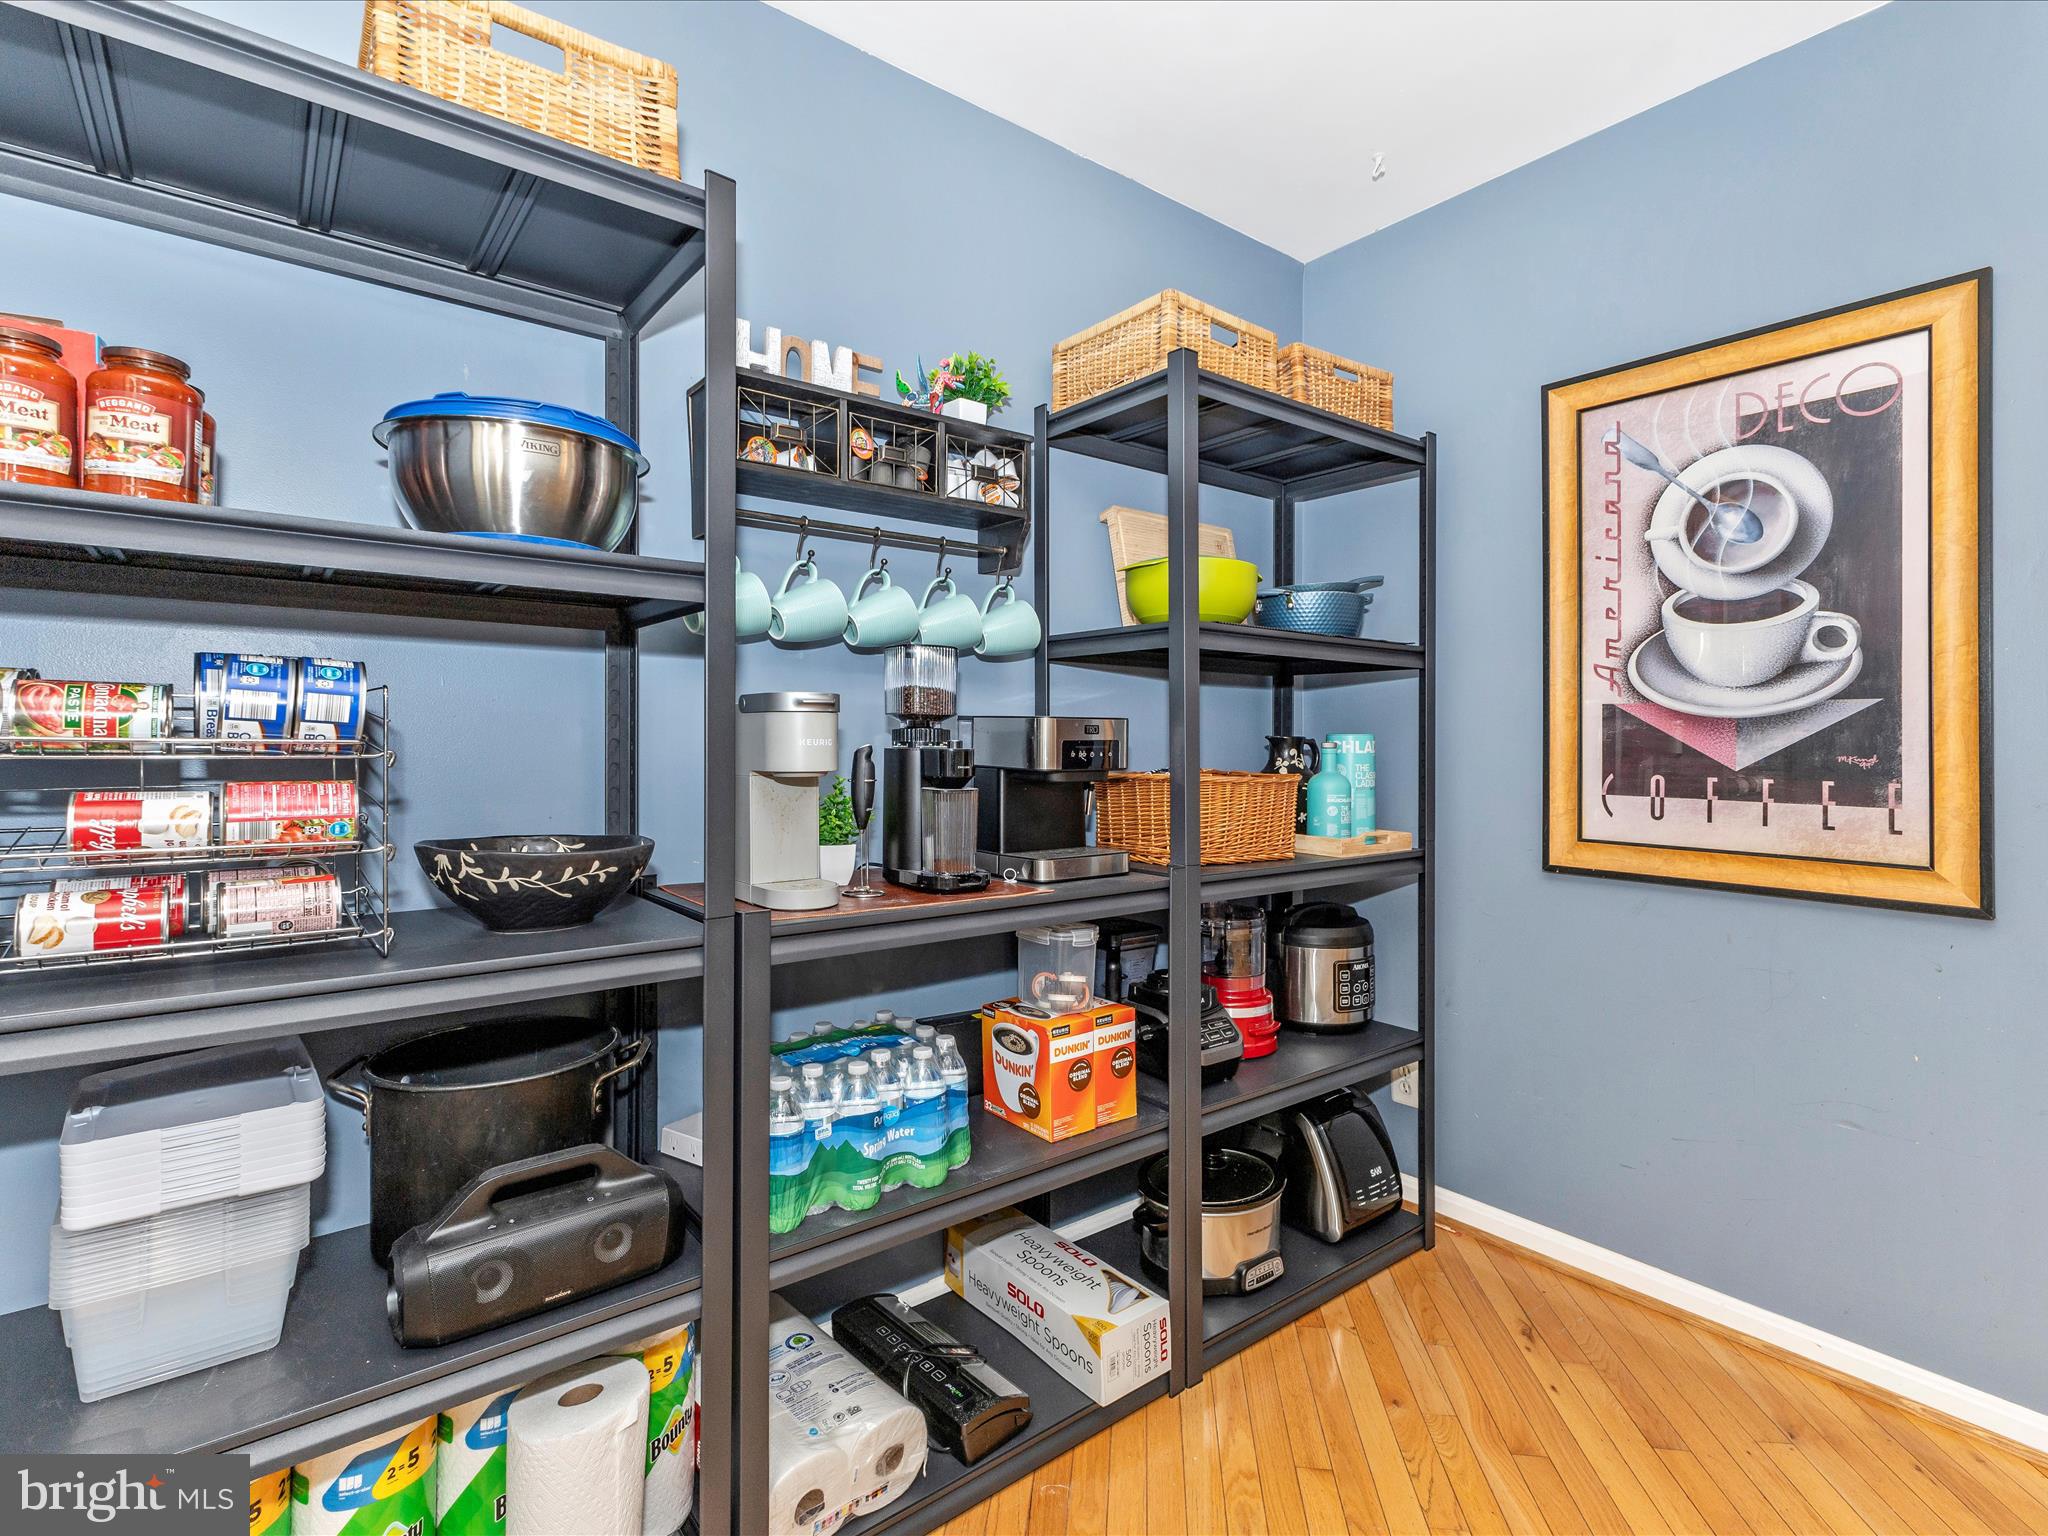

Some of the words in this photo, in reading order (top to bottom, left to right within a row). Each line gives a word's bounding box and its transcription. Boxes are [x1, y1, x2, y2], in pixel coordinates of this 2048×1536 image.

[736, 318, 884, 397] HOME
[1735, 361, 1904, 440] DECO
[110, 414, 161, 434] Meat
[1593, 421, 1624, 697] Americana
[66, 687, 82, 723] PASTE
[206, 709, 218, 738] Breas
[799, 738, 833, 746] KEURIG
[1601, 772, 1904, 835] COFFEE
[863, 1137, 887, 1157] Spring
[887, 1127, 916, 1142] Water
[1013, 1231, 1102, 1290] Heavyweight
[1016, 1249, 1069, 1288] Spoons
[1054, 1240, 1098, 1268] SOLO
[968, 1269, 1040, 1336] Heavyweight
[1043, 1326, 1094, 1375] Spoons
[1007, 1281, 1046, 1319] SOLO
[1142, 1322, 1152, 1374] Spoons
[1159, 1317, 1169, 1362] SOLO
[651, 1406, 693, 1462] Bounty
